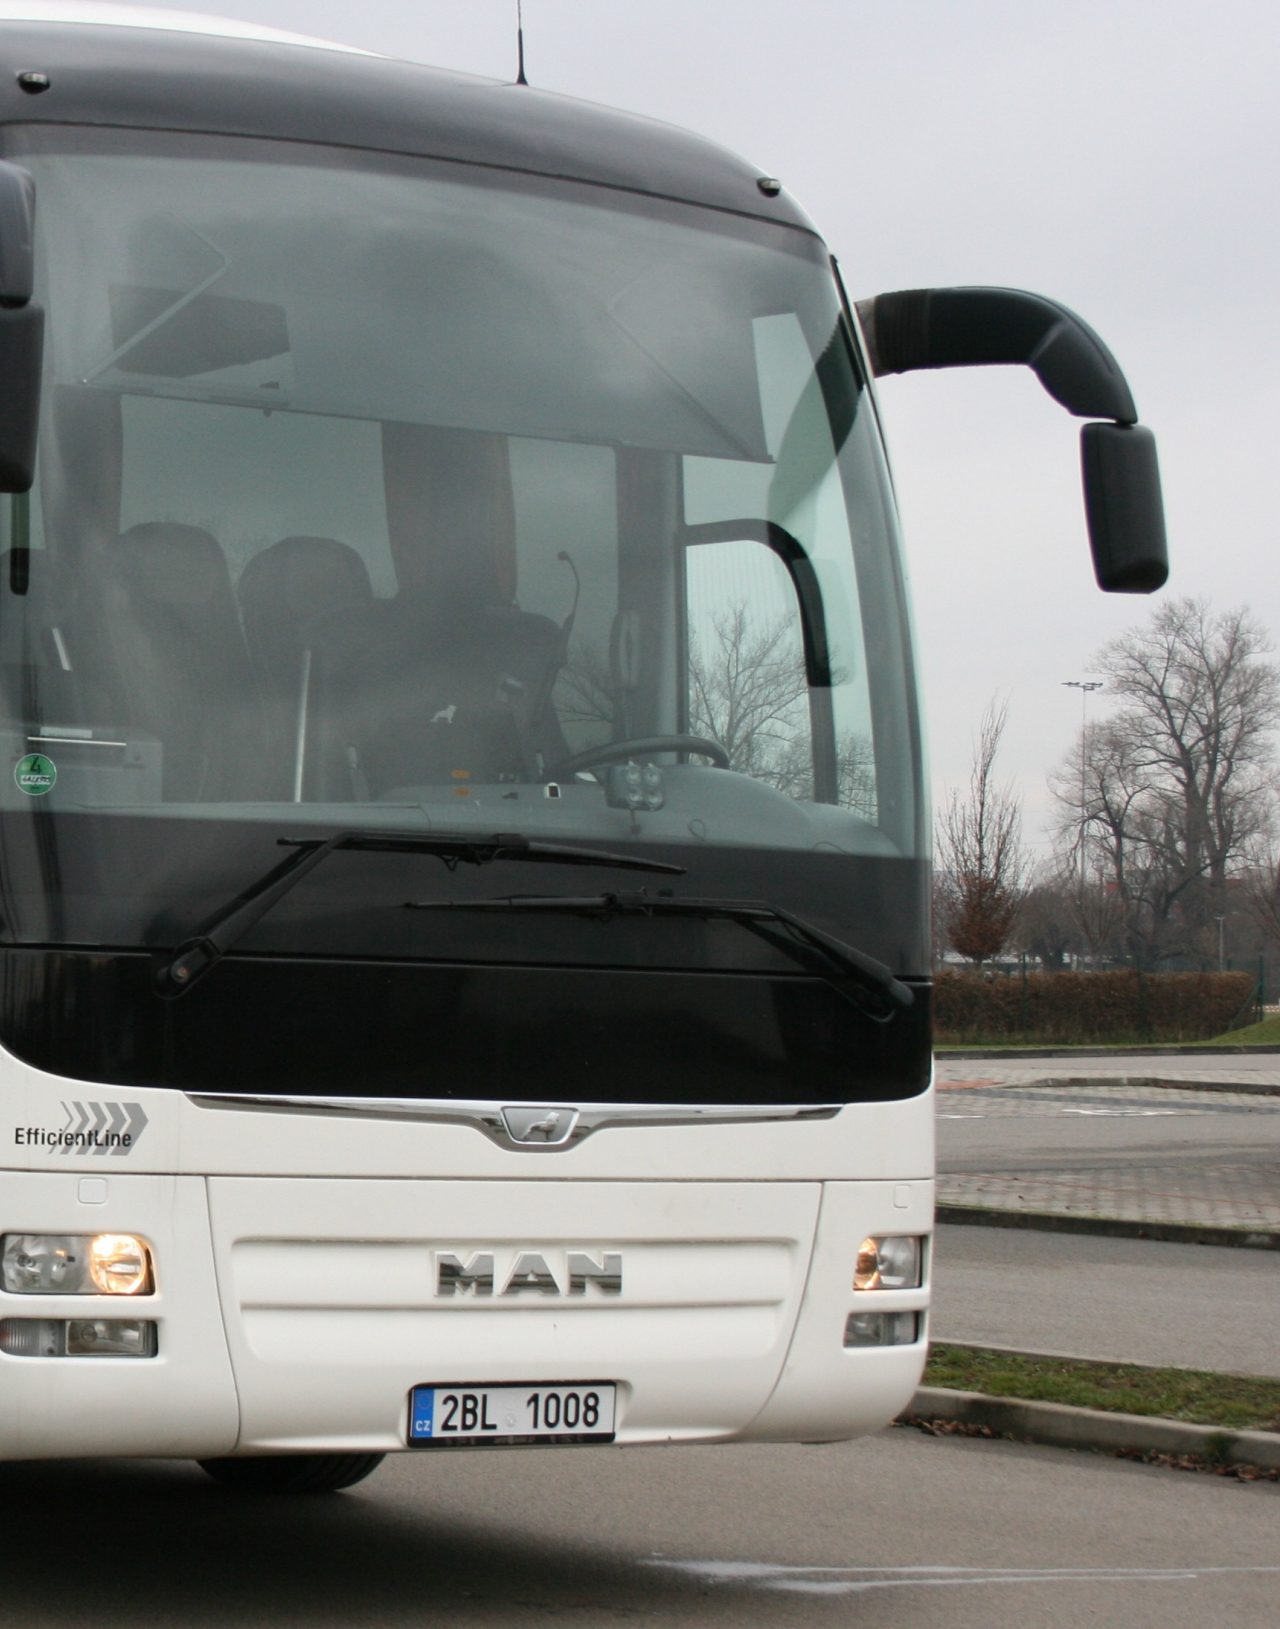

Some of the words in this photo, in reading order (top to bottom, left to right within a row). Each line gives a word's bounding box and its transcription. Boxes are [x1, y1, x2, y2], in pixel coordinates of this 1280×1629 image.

[15, 1127, 132, 1147] EfficientLine
[434, 1251, 622, 1297] MAN
[415, 1420, 431, 1431] CZ
[441, 1394, 497, 1431] 2BL
[526, 1392, 600, 1429] 1008
